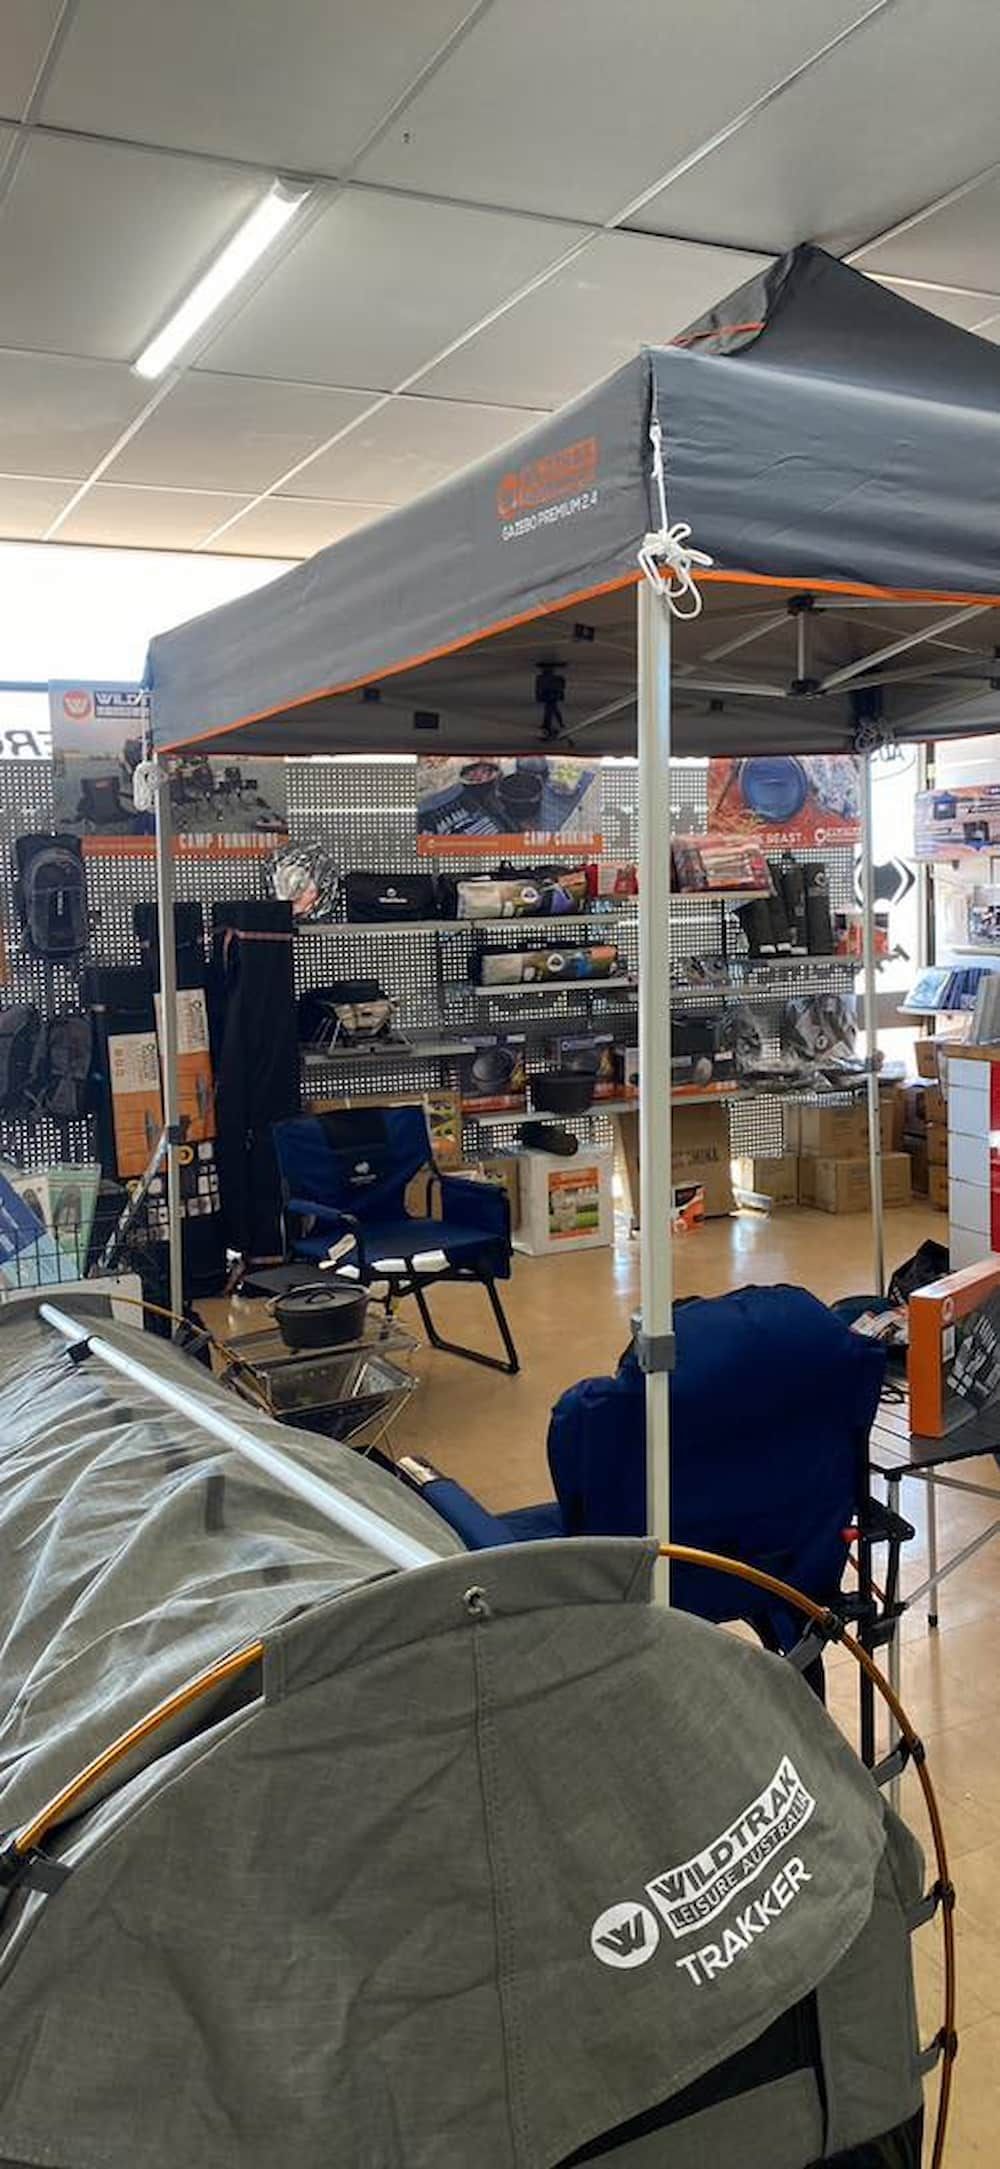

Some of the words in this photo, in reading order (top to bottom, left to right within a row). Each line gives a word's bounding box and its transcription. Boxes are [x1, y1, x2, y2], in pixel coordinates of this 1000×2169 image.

[501, 514, 537, 541] GAZEBO
[538, 497, 580, 525] PREMIUM
[180, 832, 213, 849] CAMP
[651, 1765, 797, 1904] WILDTRAK
[669, 1869, 739, 1928] LEISURE
[741, 1788, 812, 1874] AUSTRALIA
[675, 1856, 813, 1987] TRAKKER
